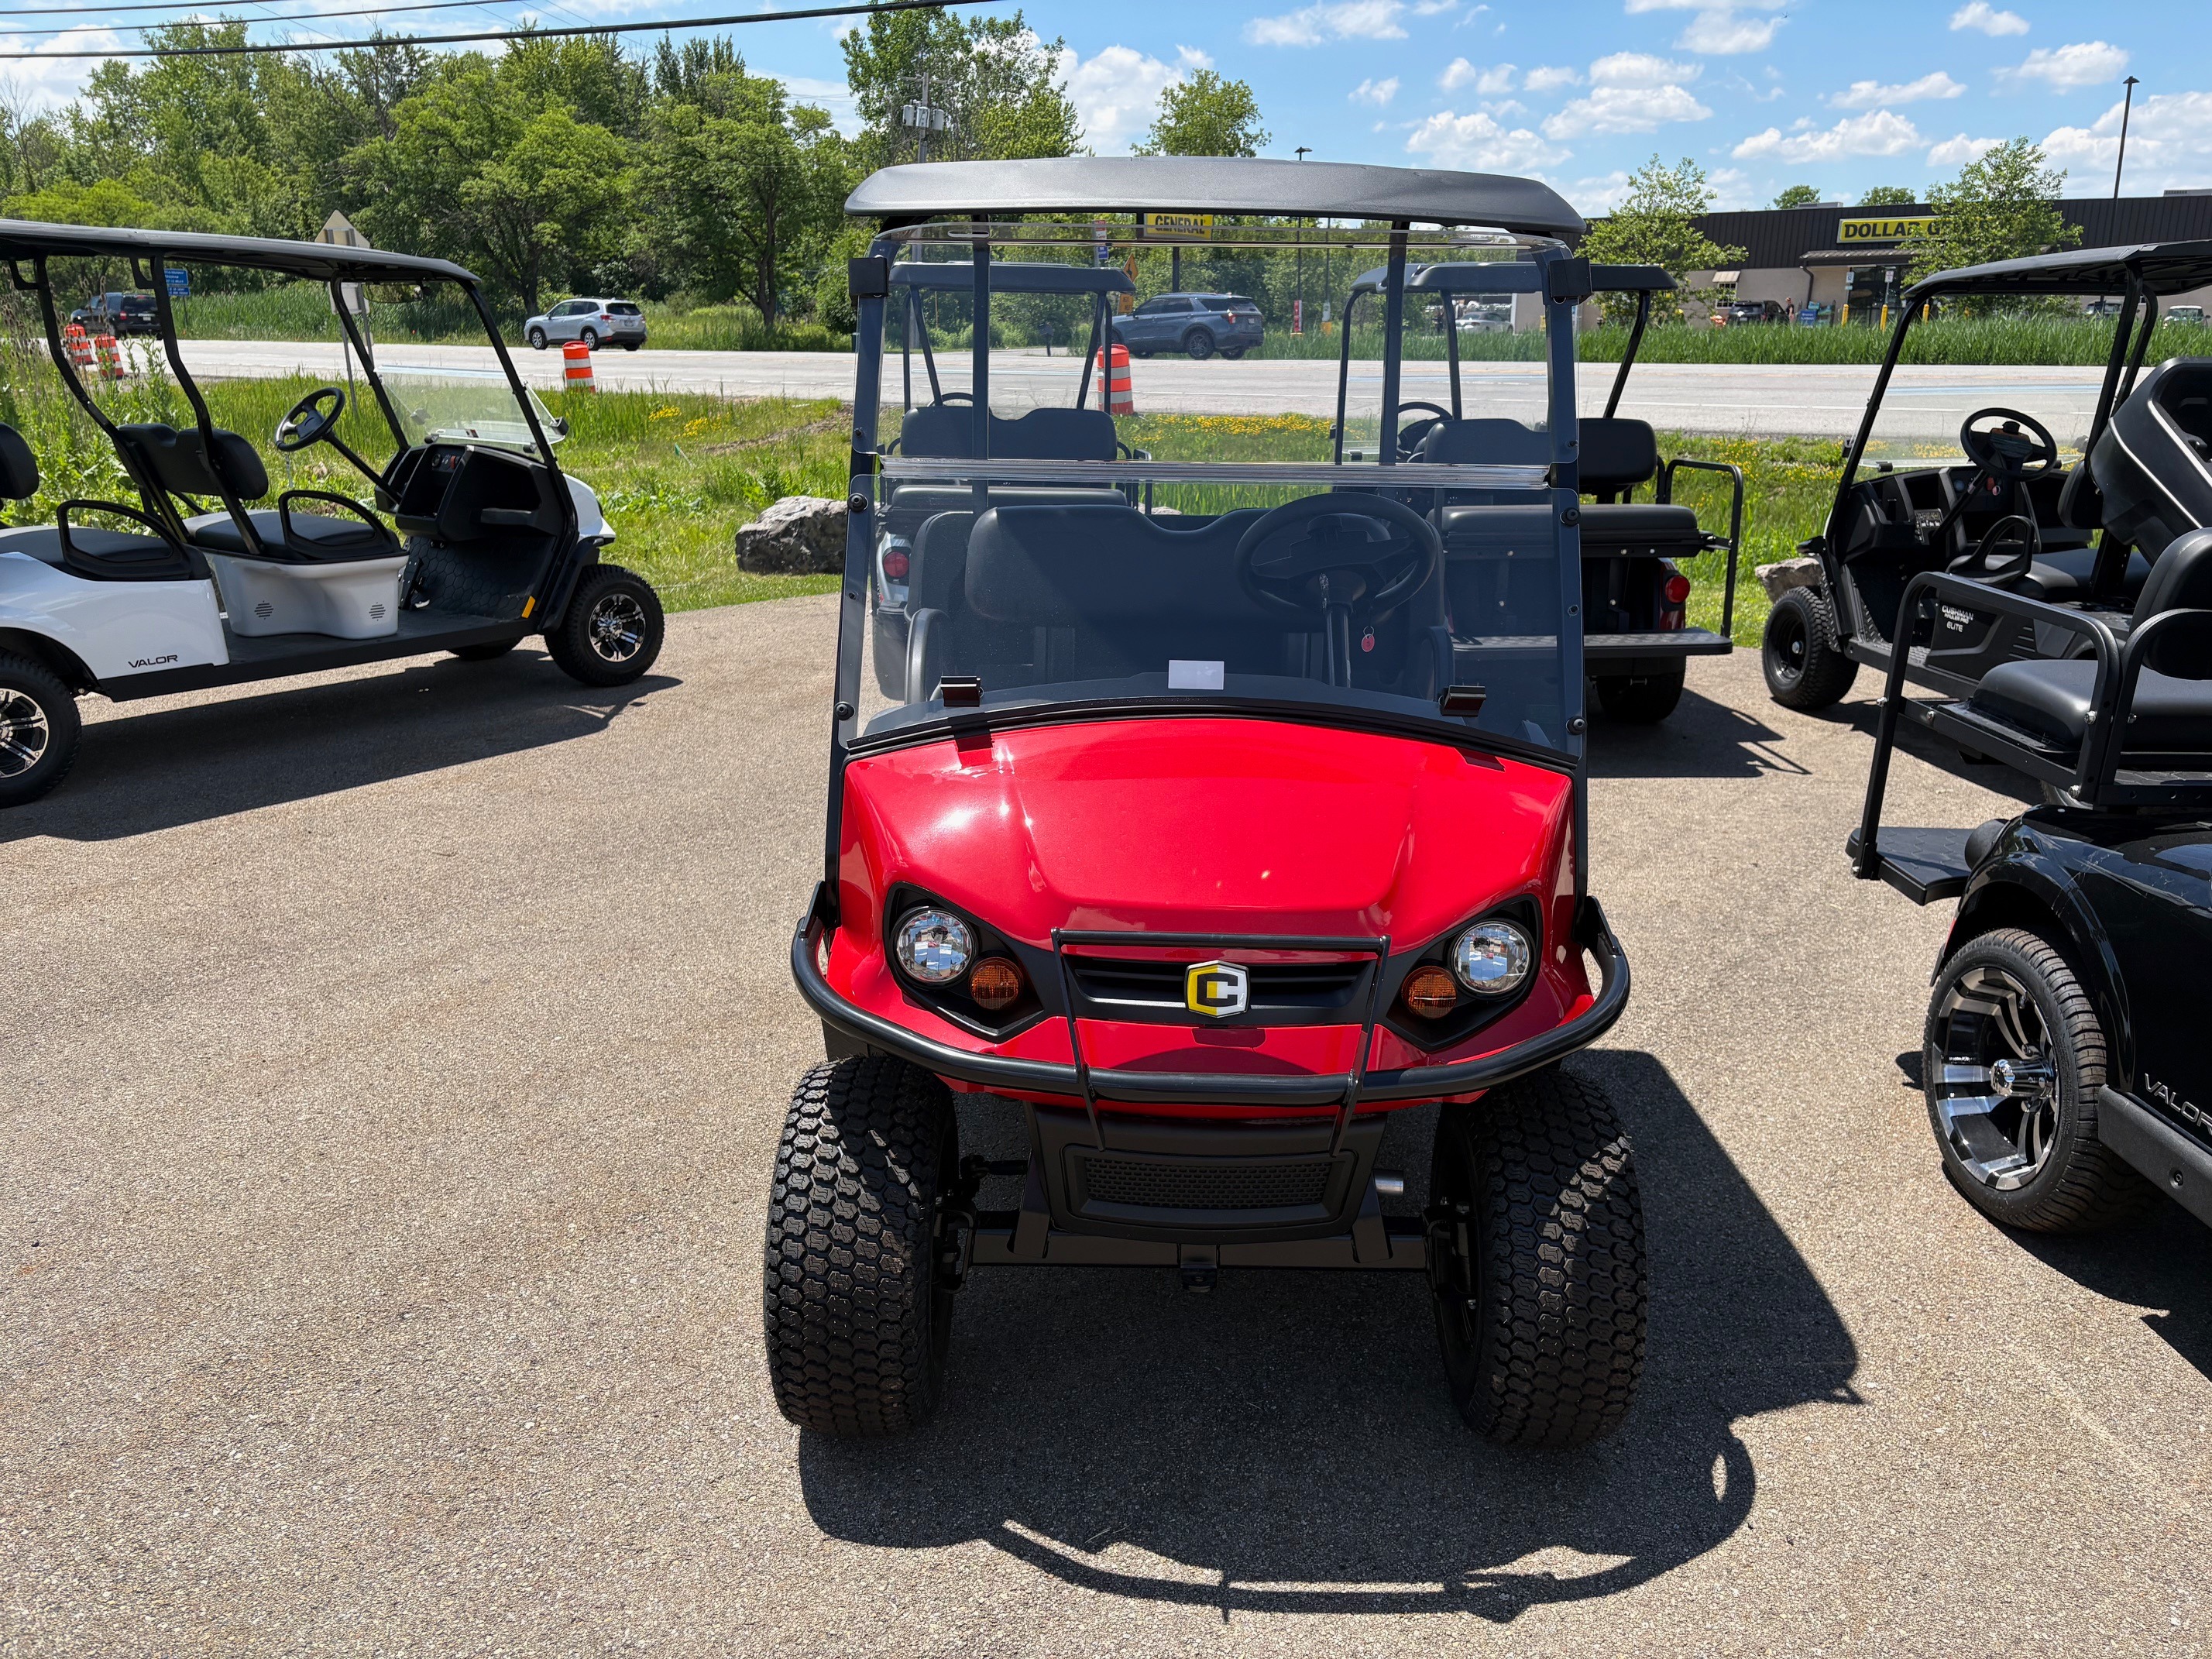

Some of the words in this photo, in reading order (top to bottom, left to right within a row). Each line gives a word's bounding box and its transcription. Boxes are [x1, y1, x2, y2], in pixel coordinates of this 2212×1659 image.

[1155, 215, 1205, 234] GENERAL
[1946, 620, 1963, 632] ELITE
[128, 654, 178, 668] VALOR
[2145, 1073, 2212, 1135] VALOR
